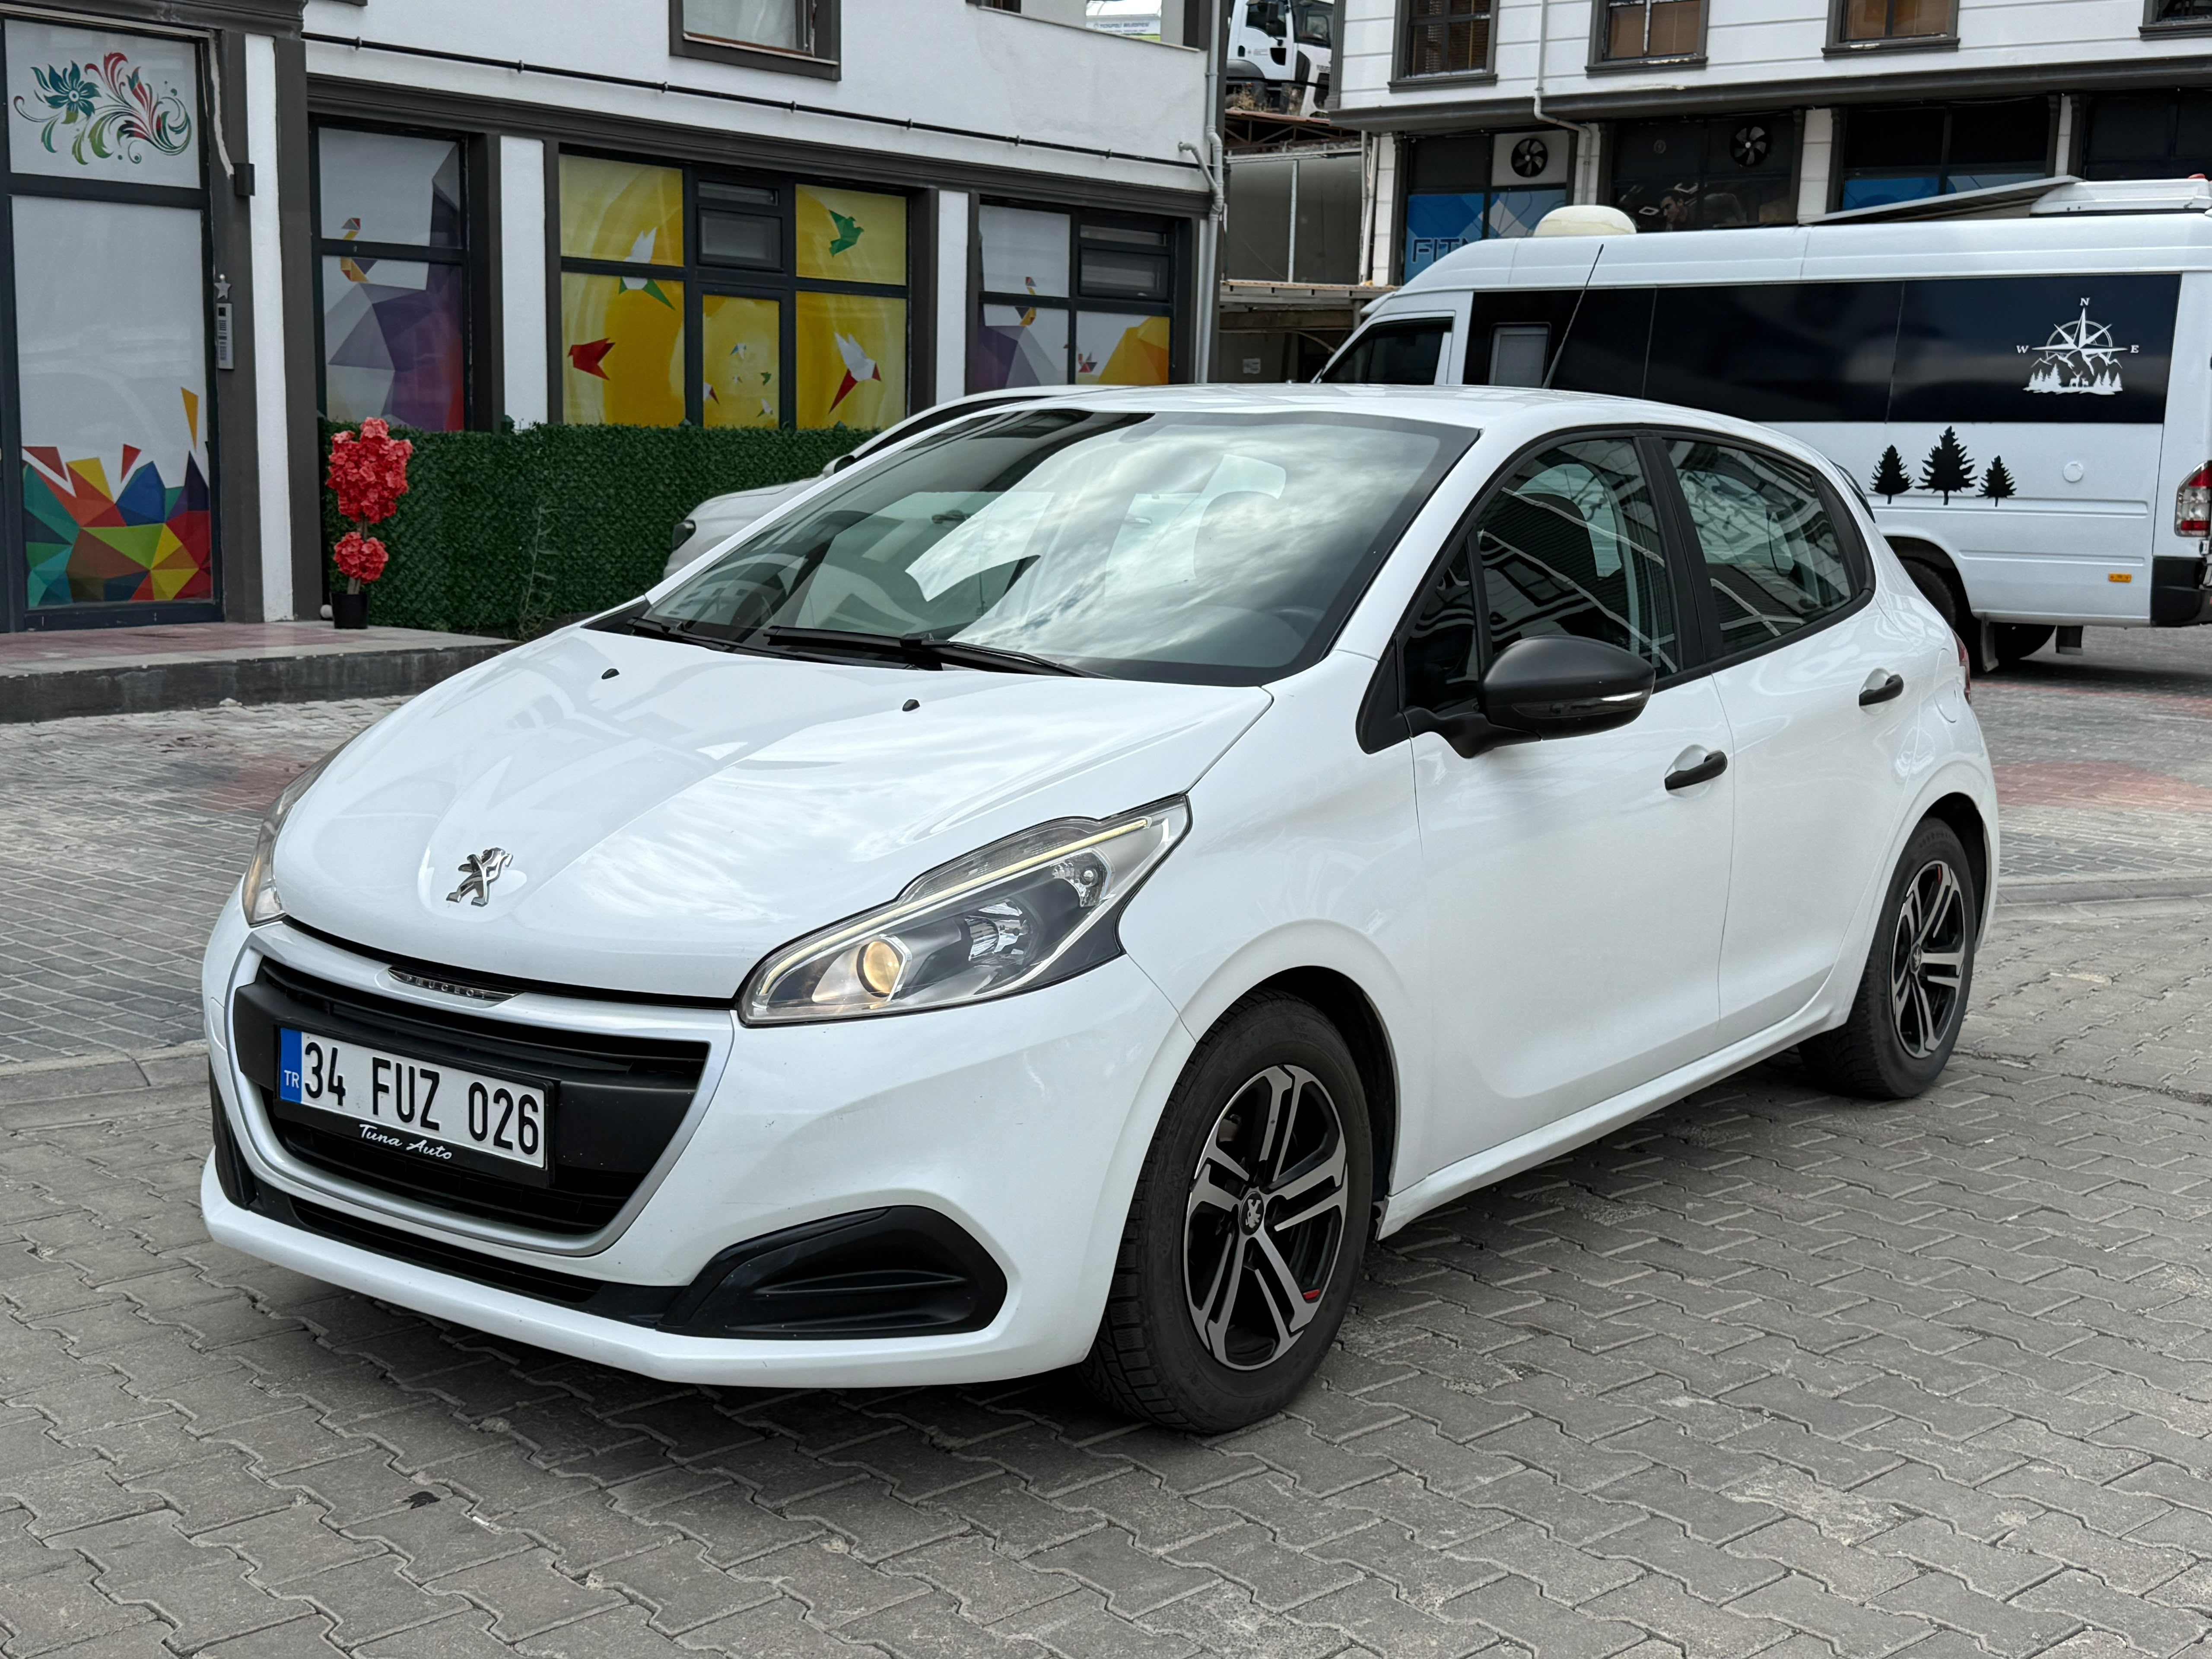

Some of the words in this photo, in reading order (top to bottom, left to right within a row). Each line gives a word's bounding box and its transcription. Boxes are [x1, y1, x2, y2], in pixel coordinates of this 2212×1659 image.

[1411, 238, 1469, 263] FIT
[2079, 297, 2090, 306] N
[2016, 345, 2029, 354] W
[2130, 345, 2139, 353] E
[283, 1069, 299, 1089] TR
[305, 1041, 346, 1107] 34
[372, 1056, 440, 1131] FUZ
[469, 1081, 539, 1155] 026
[359, 1124, 403, 1147] Tuna
[406, 1140, 452, 1160] Auto
